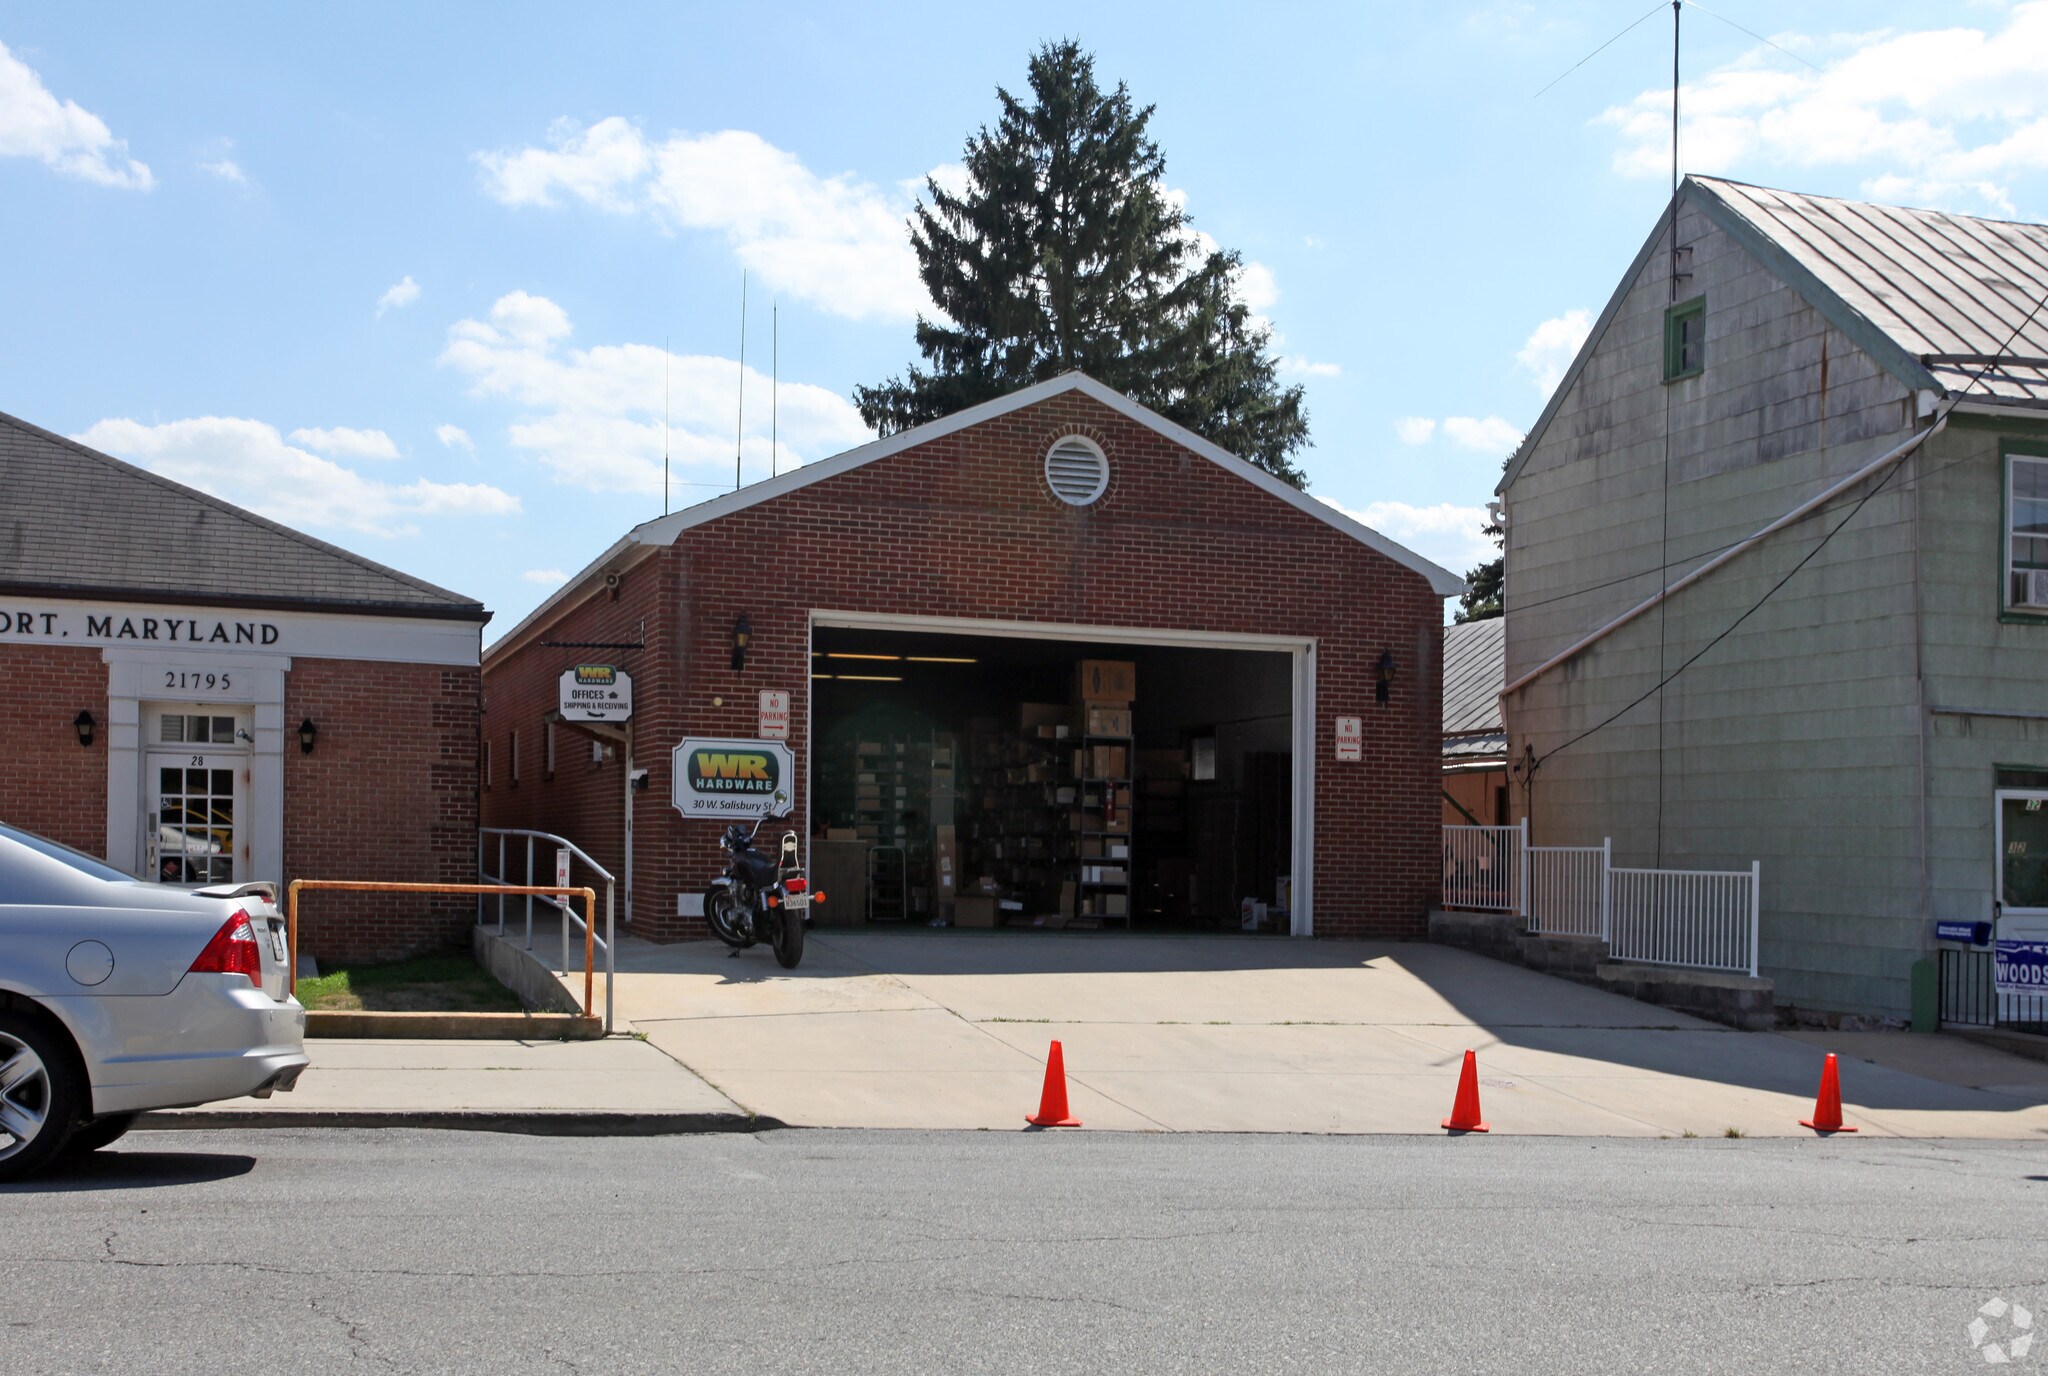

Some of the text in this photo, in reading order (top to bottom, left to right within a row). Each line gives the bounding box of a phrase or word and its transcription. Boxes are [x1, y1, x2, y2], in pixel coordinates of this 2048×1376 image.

[86, 615, 279, 645] MARYLAND
[165, 671, 231, 690] 21795
[571, 689, 605, 700] OFFICES
[563, 701, 591, 709] SHIPPING
[597, 702, 629, 710] RECEIVING
[769, 699, 779, 708] NO
[761, 711, 788, 721] PARKING
[1345, 724, 1353, 733] NO
[1337, 735, 1361, 744] PARKING
[191, 755, 204, 766] 28
[696, 778, 772, 791] HARDWARE
[693, 799, 705, 809] 30
[706, 800, 718, 809] W.
[719, 800, 761, 812] Salisbury
[2027, 799, 2040, 810] 32
